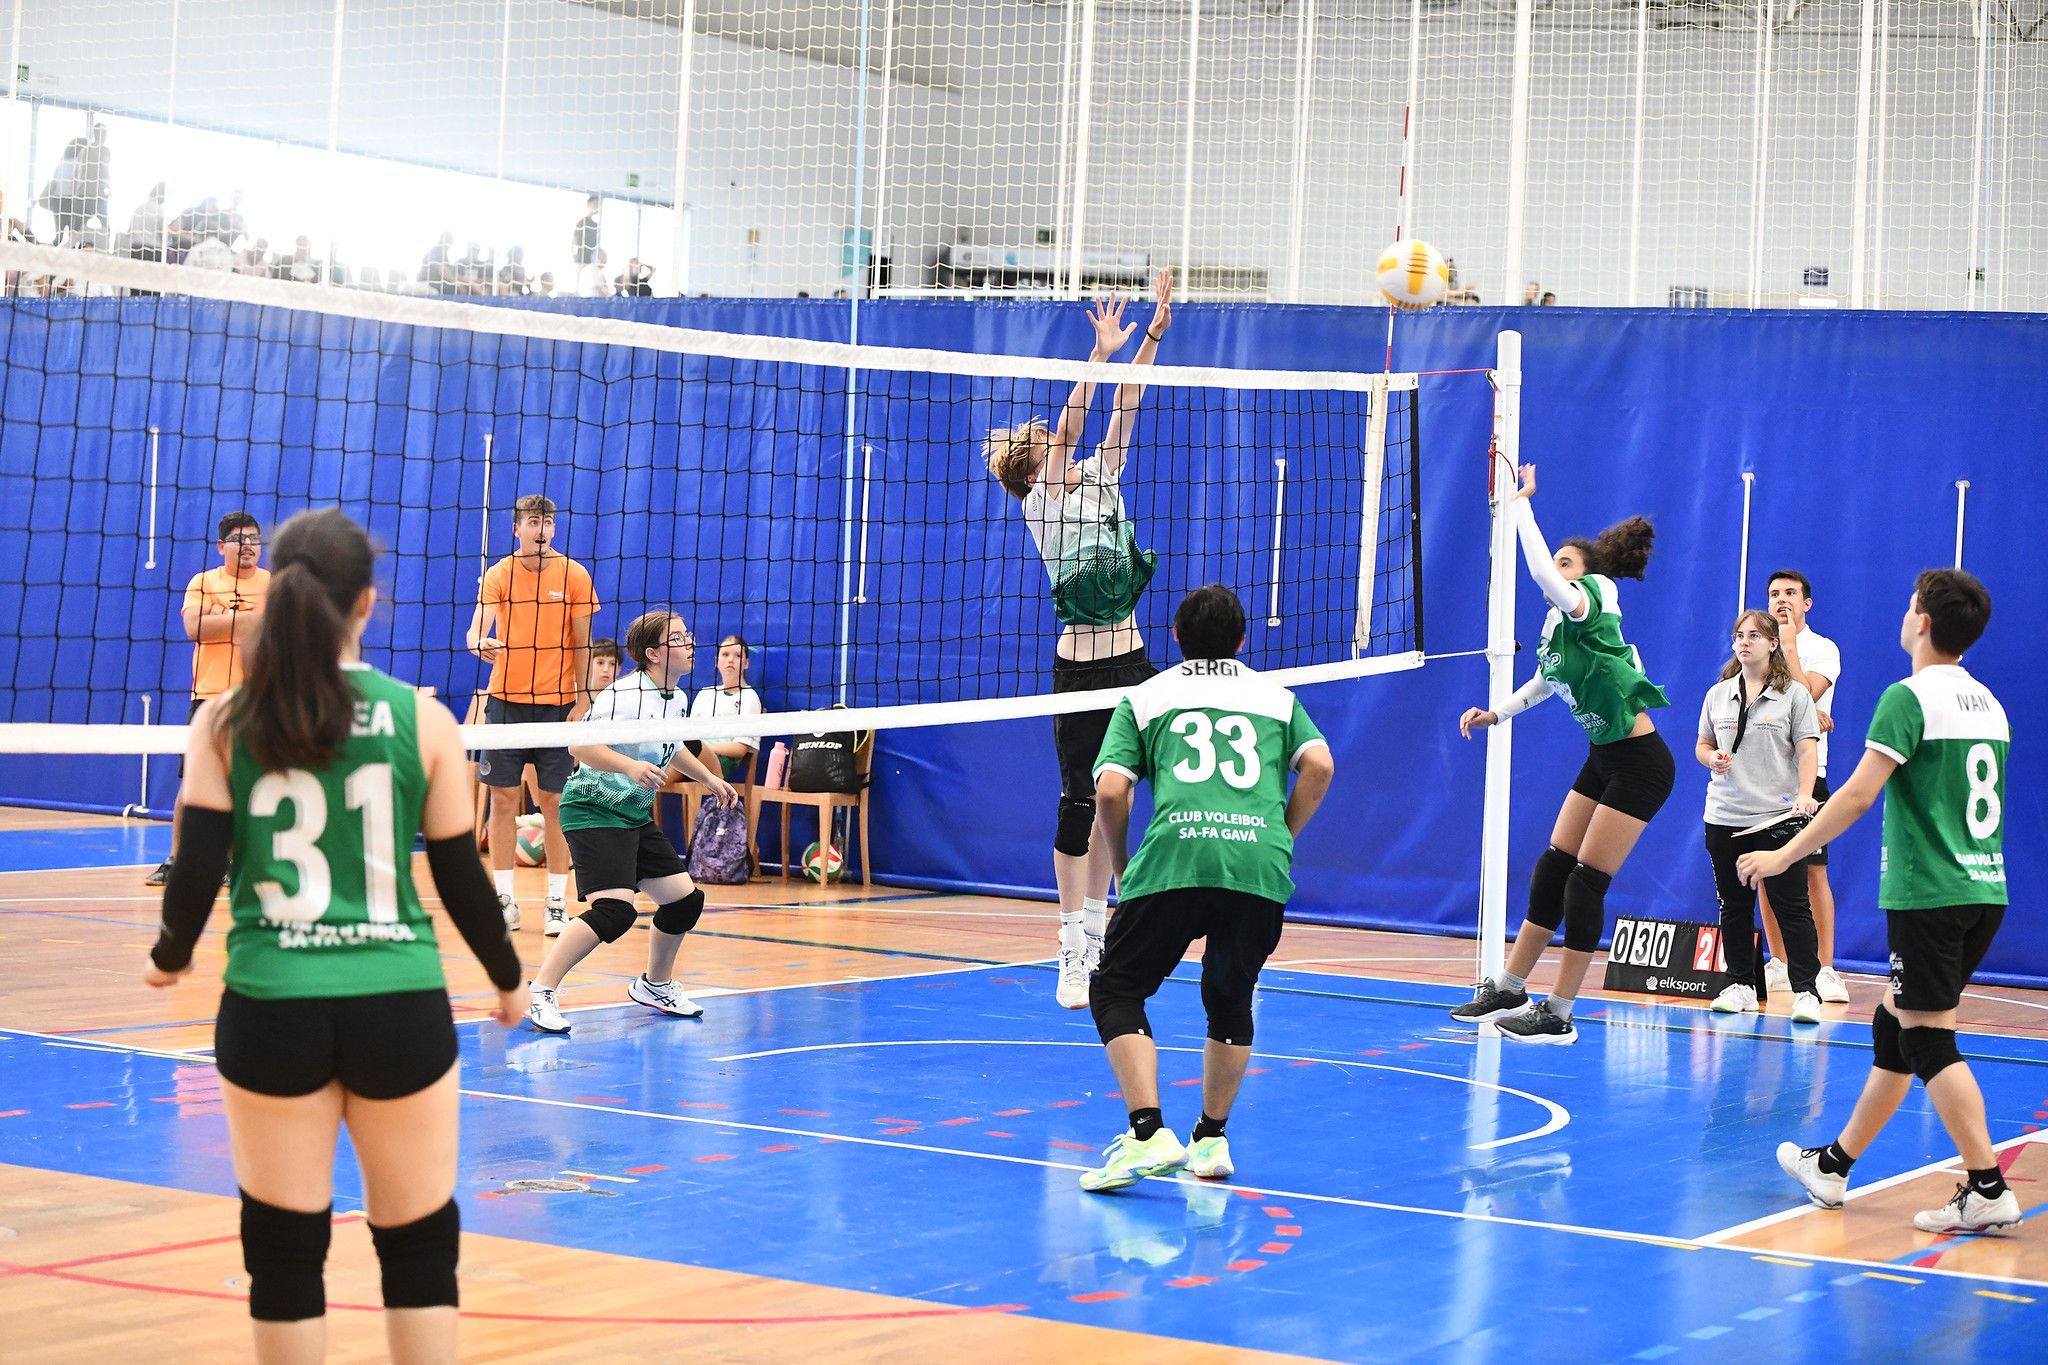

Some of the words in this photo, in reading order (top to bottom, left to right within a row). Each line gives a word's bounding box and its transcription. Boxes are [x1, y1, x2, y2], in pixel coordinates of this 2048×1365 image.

[1182, 660, 1239, 677] SERGI
[1957, 694, 1990, 712] IVAN
[351, 700, 396, 738] EA
[797, 741, 843, 750] DUNLOP
[1169, 711, 1261, 789] 33
[1966, 743, 2001, 840] 8
[1168, 810, 1202, 824] CLUB
[1204, 811, 1267, 828] VOLEIBOL
[1179, 827, 1220, 839] SA-FA
[250, 762, 400, 923] 31
[1659, 976, 1707, 993] elksport
